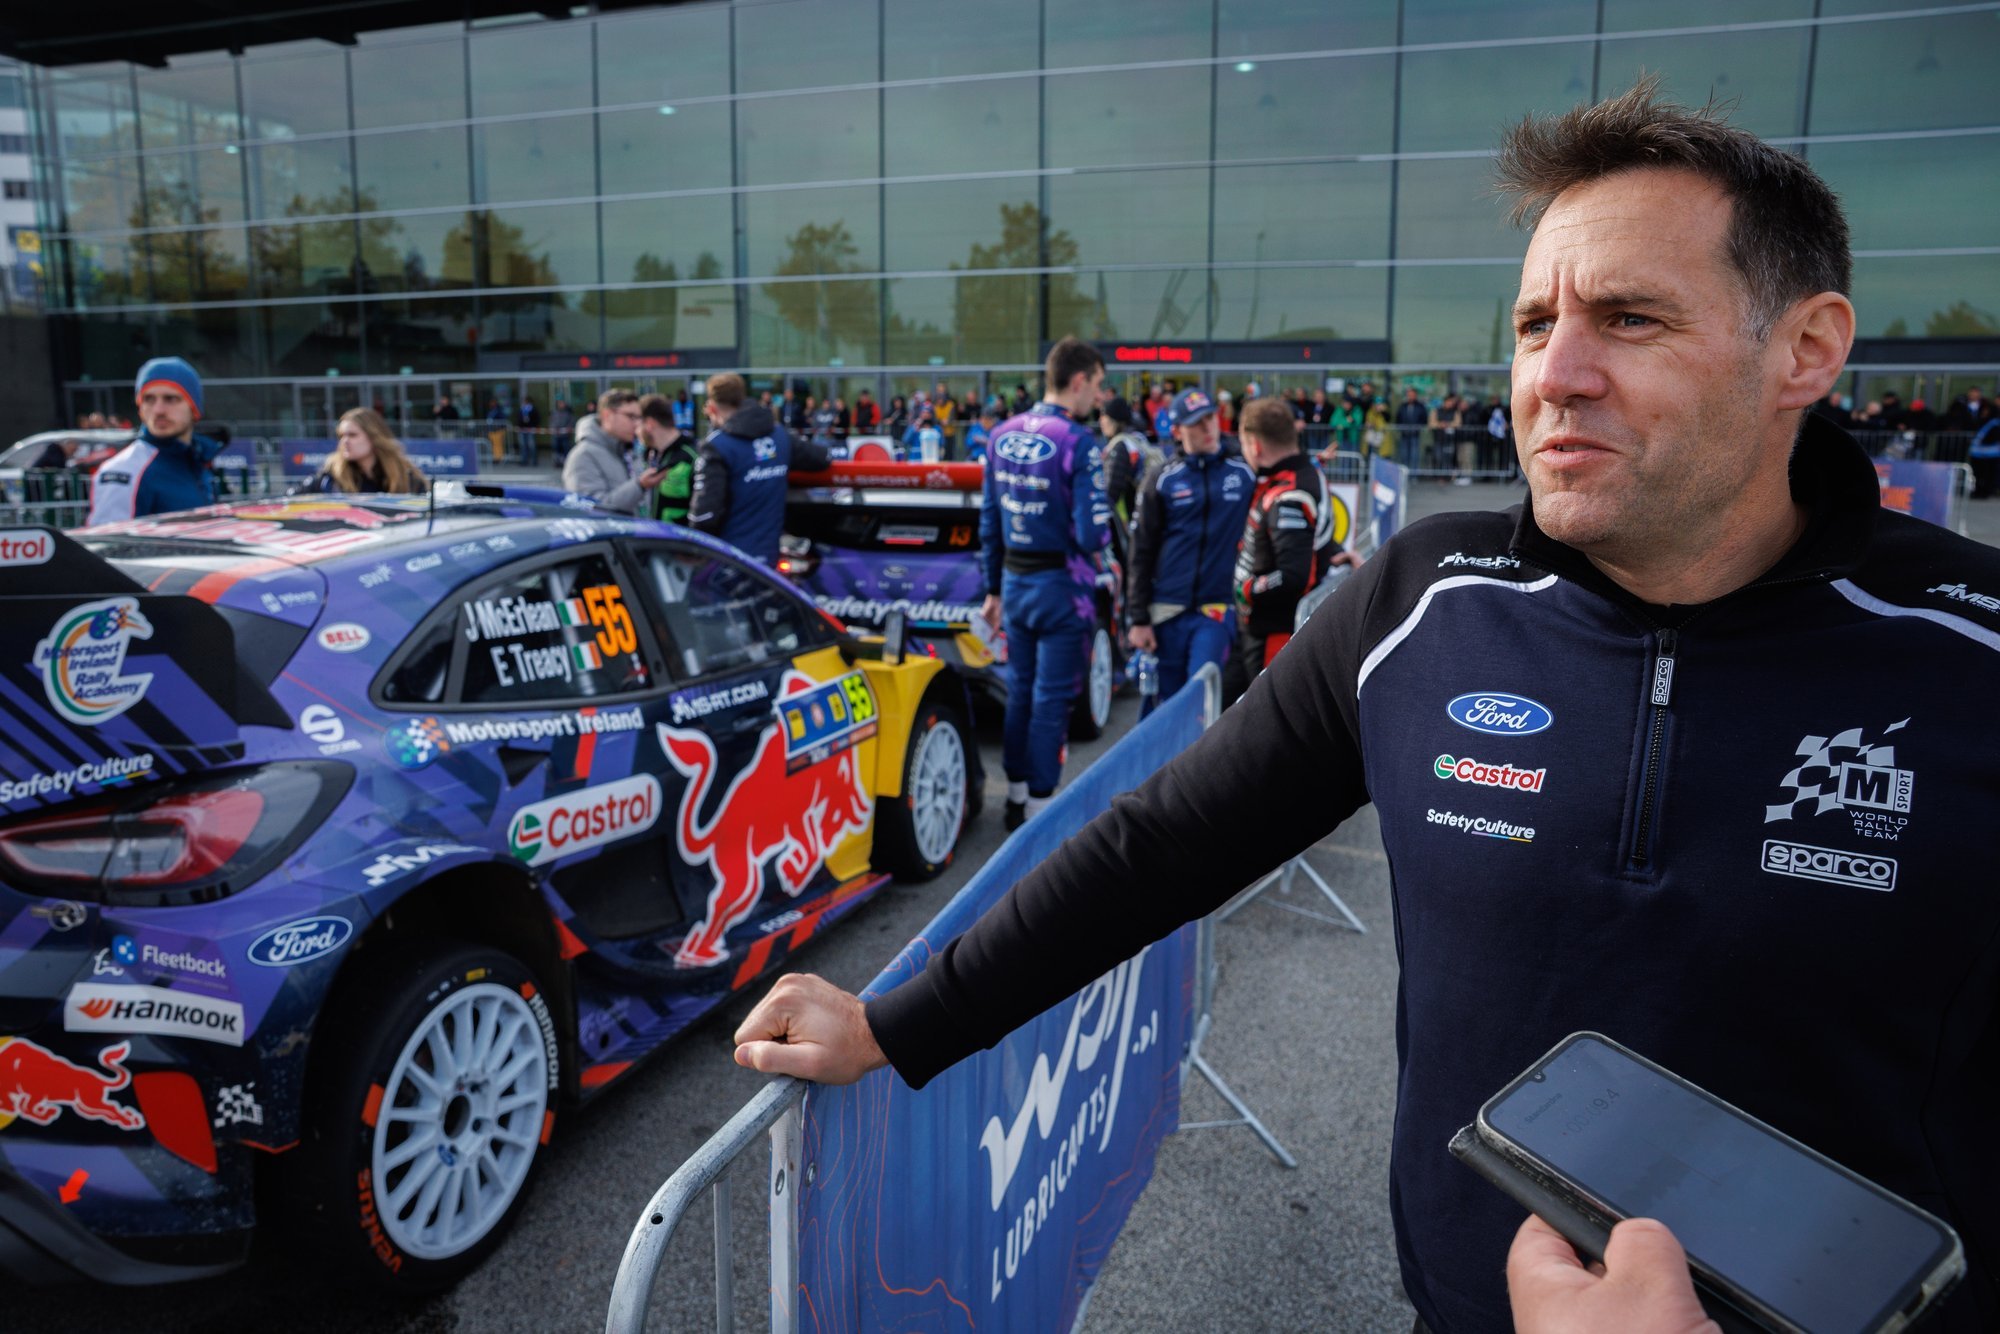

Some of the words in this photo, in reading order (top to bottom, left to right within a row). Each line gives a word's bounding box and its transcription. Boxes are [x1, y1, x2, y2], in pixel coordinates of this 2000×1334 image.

[325, 629, 363, 645] BELL
[464, 601, 479, 643] J
[476, 595, 561, 641] McErlean
[582, 584, 638, 658] 55
[75, 671, 112, 687] Rally
[490, 646, 514, 687] E
[509, 643, 573, 684] Treacy
[1654, 659, 1670, 704] sparco
[446, 714, 573, 744] Motorsport
[576, 707, 645, 735] Ireland
[1465, 697, 1531, 730] Ford
[0, 753, 155, 804] SafetyCulture
[1455, 758, 1546, 793] Castrol
[1847, 768, 1888, 805] M
[1896, 772, 1912, 810] SPORT
[547, 783, 653, 849] Castrol
[1426, 808, 1536, 840] SafetyCulture
[1850, 810, 1908, 826] WORLD
[1853, 819, 1904, 833] RALLY
[1854, 827, 1899, 841] TEAM
[1767, 844, 1892, 887] sparco
[269, 922, 337, 963] Ford
[142, 944, 227, 979] Fleetback
